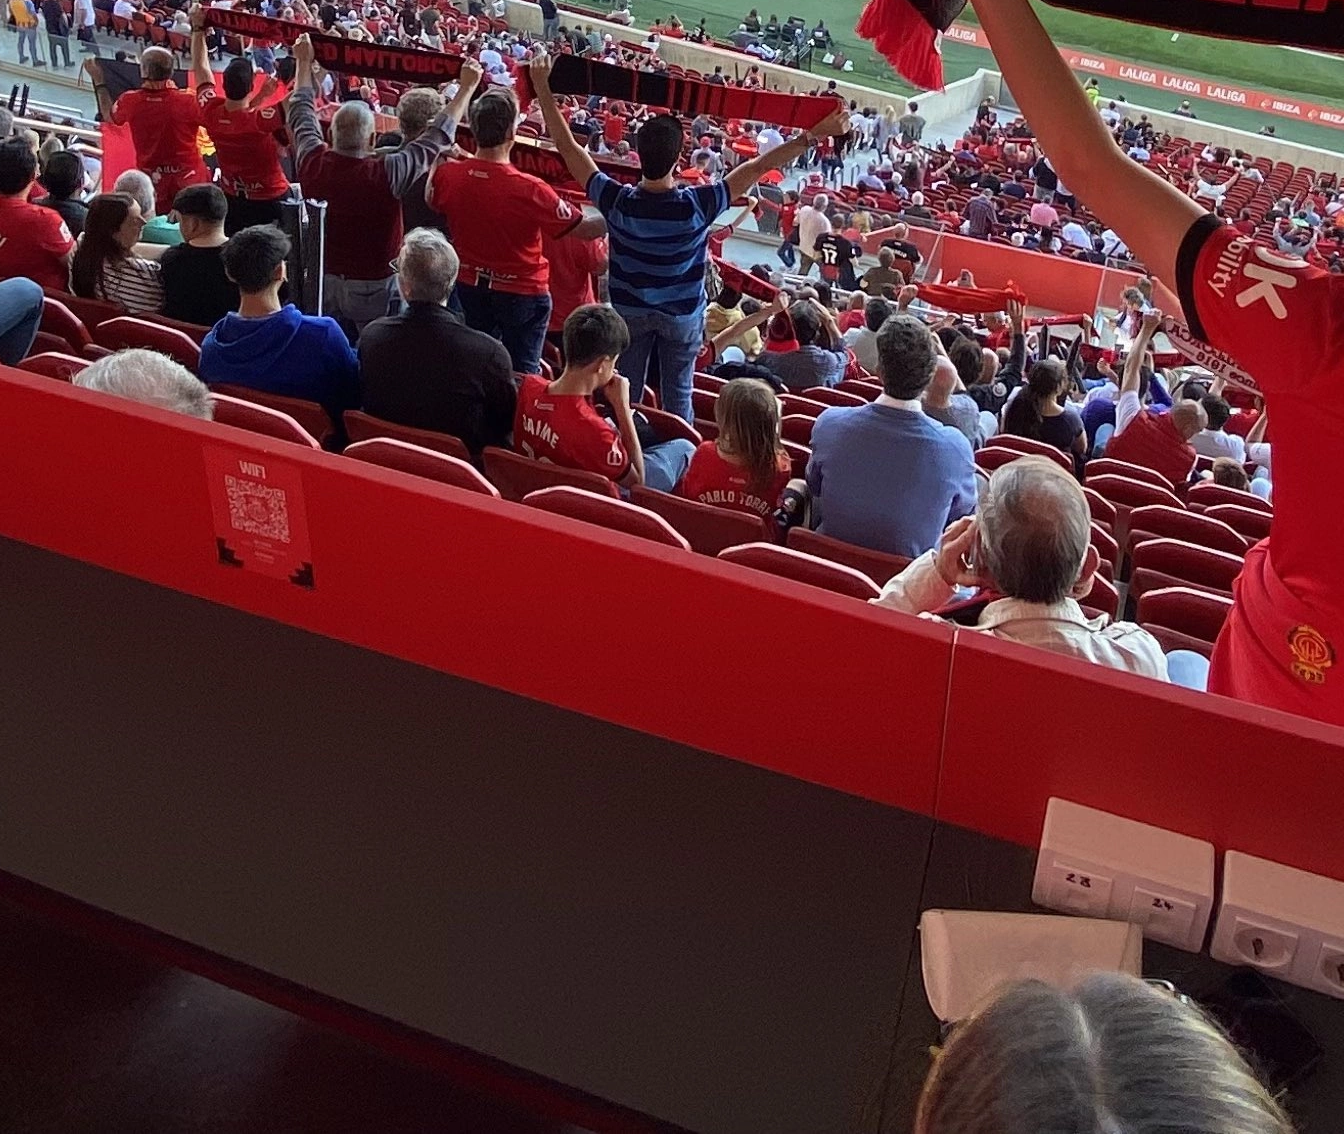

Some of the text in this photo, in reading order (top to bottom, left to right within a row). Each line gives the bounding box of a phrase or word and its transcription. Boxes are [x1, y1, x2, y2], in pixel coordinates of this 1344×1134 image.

[1080, 57, 1106, 71] IBIZA
[1119, 66, 1247, 104] LALIGA LALIGA LALIGA
[1272, 101, 1301, 115] IBIZA
[821, 248, 838, 265] 17
[239, 460, 267, 479] WIFI
[698, 489, 735, 505] PABLO
